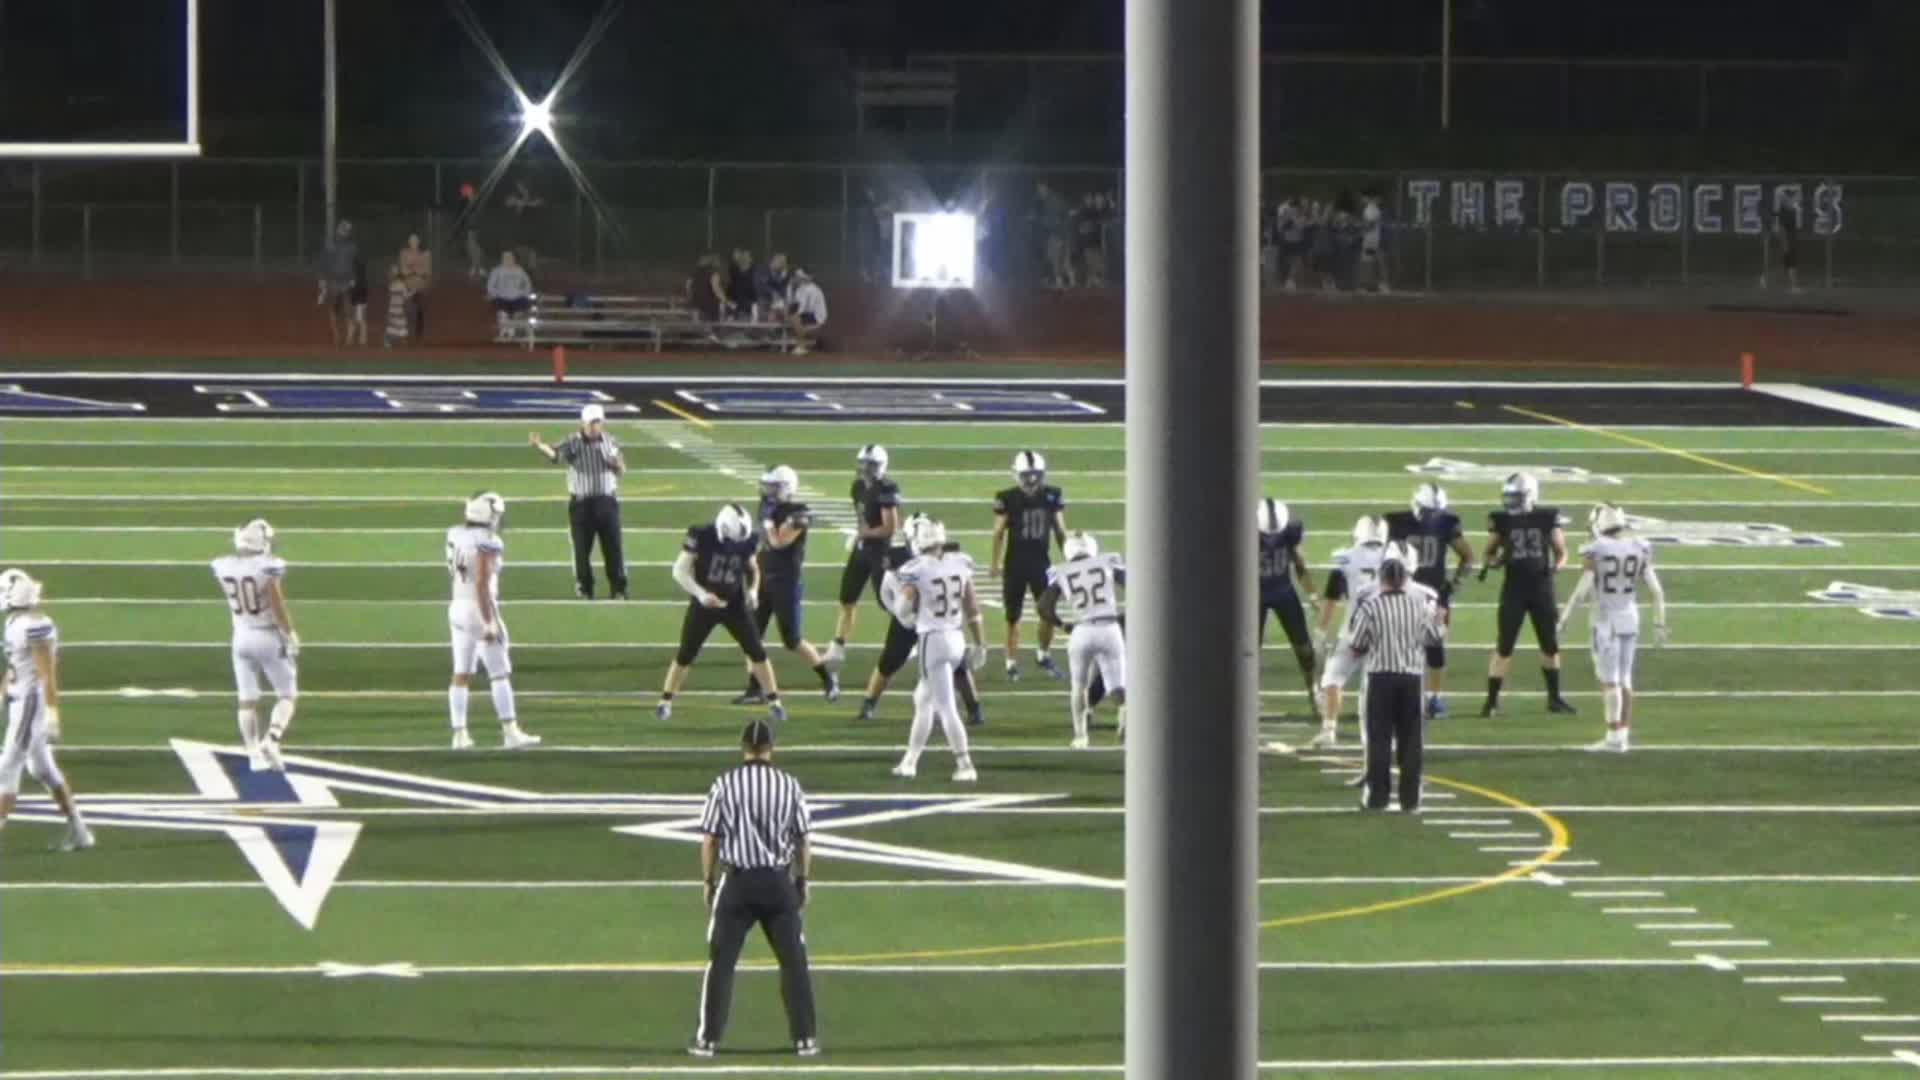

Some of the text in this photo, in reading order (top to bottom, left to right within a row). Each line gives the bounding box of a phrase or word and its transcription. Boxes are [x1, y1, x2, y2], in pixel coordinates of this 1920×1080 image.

[1408, 180, 1524, 225] THE
[1021, 508, 1047, 540] 10
[1510, 527, 1543, 560] 33
[1066, 567, 1107, 609] 52
[1602, 554, 1639, 595] 29
[222, 576, 262, 616] 30
[931, 574, 963, 618] 33
